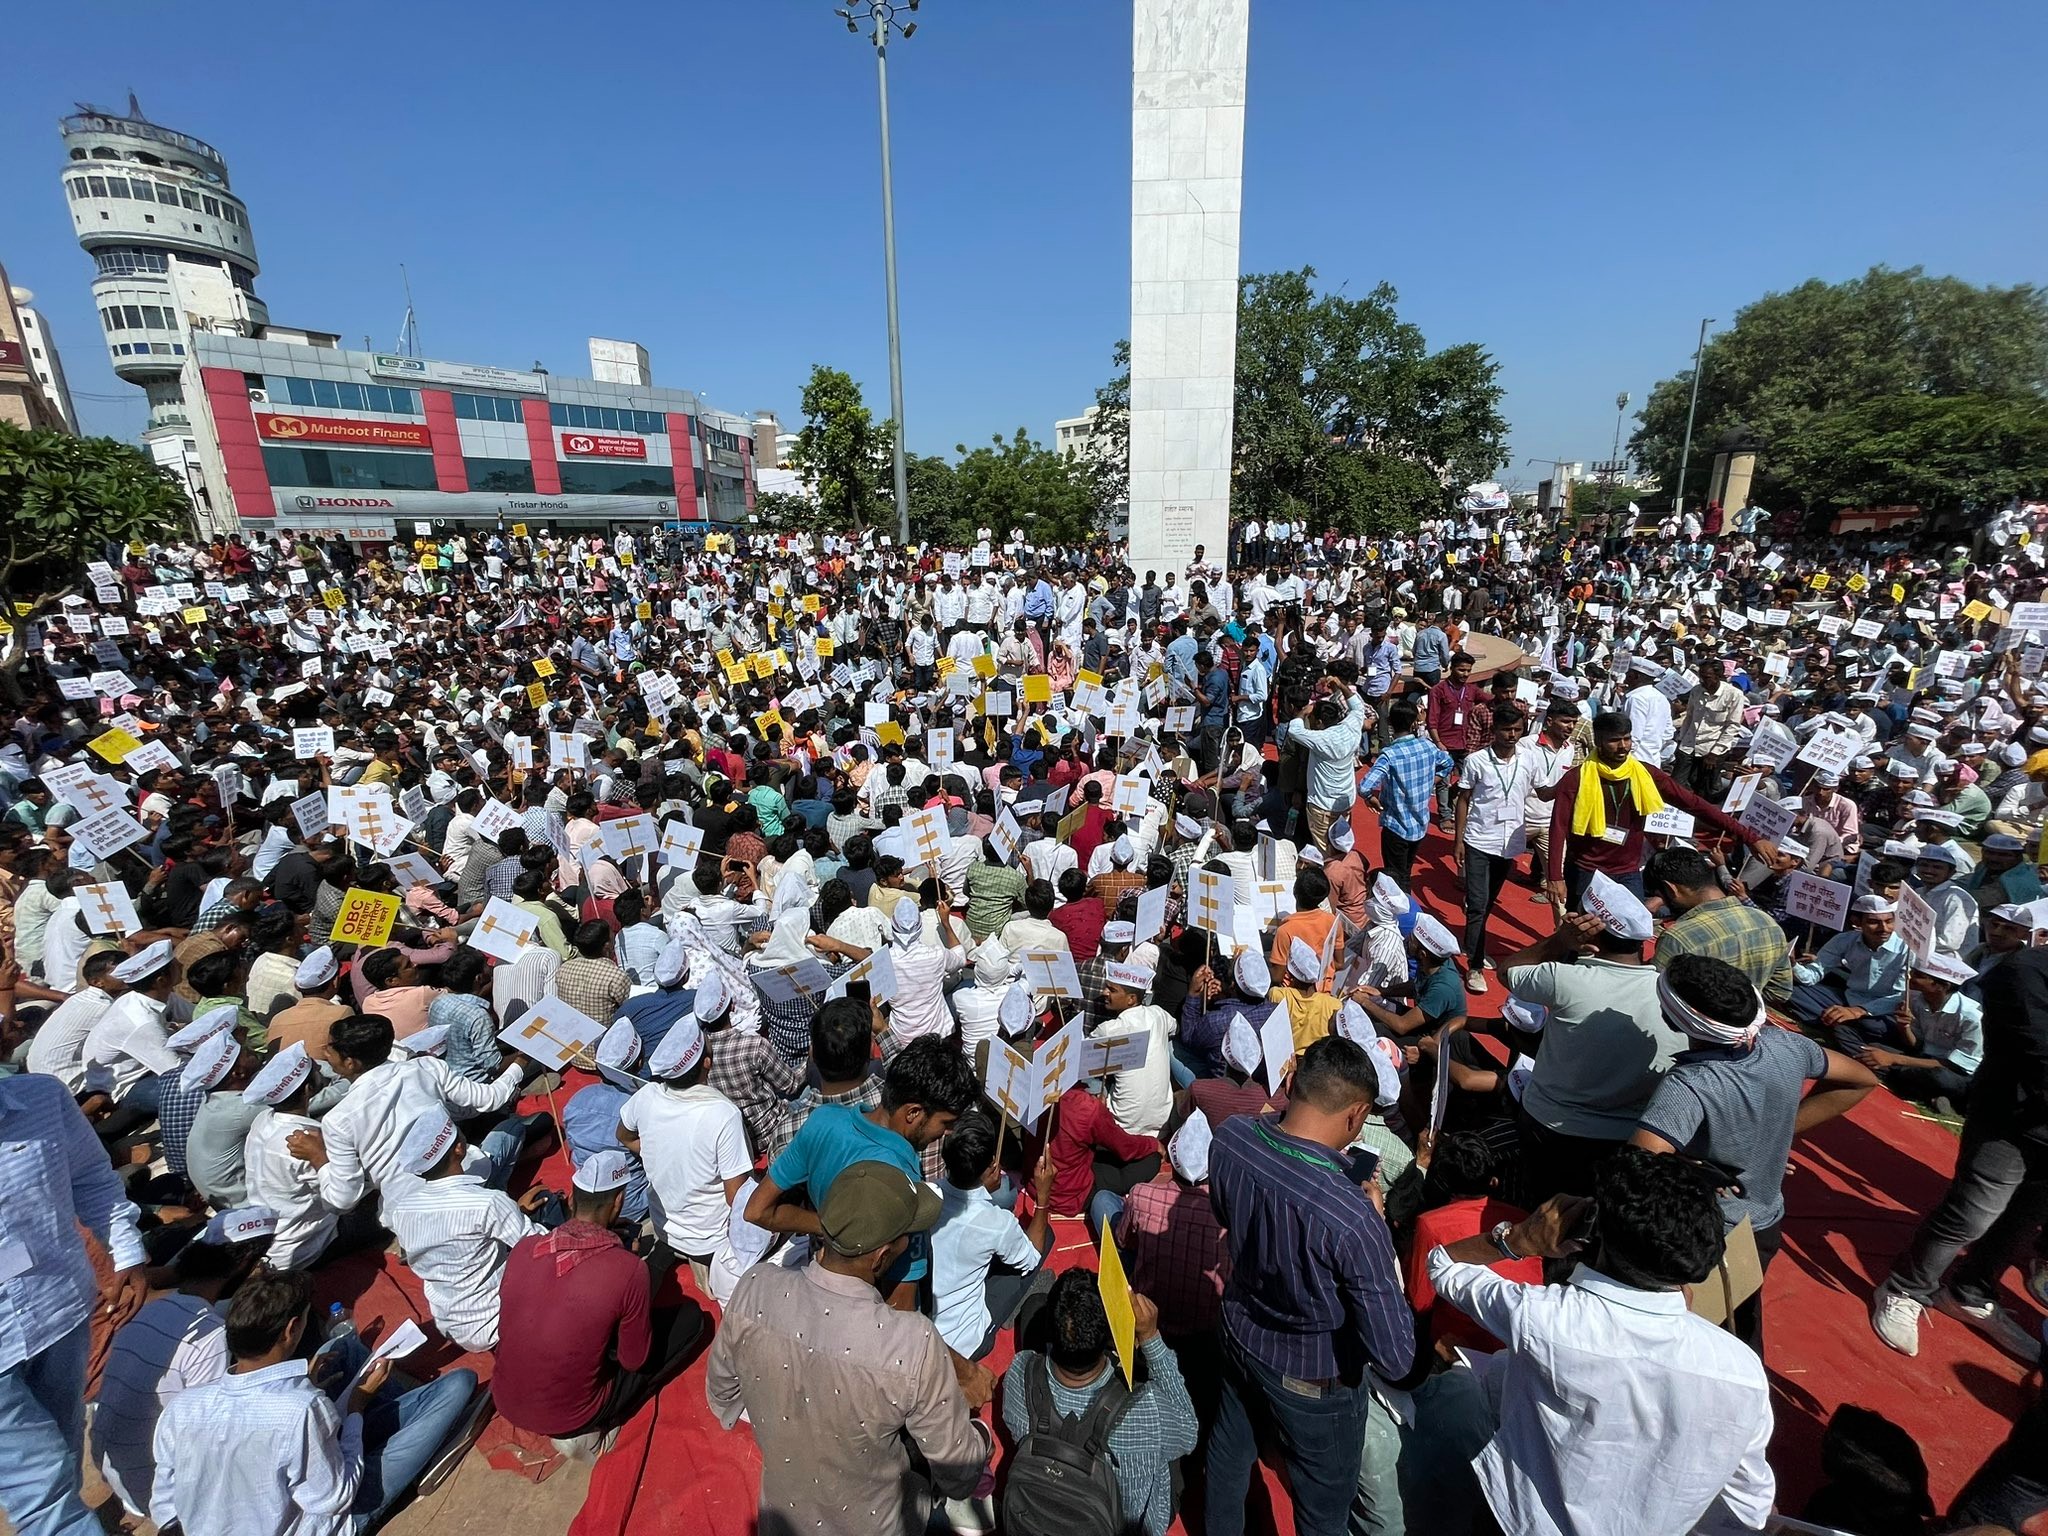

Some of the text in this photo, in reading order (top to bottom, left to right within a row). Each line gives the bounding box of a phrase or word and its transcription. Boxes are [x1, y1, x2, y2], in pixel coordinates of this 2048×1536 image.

[311, 423, 420, 440] Muthoot Finance
[317, 497, 393, 507] HONDA
[508, 501, 568, 509] Tristar Honda
[349, 529, 387, 538] BLDG
[333, 590, 344, 604] OBC
[759, 712, 776, 724] OBC
[1652, 812, 1670, 820] OBC
[1745, 813, 1760, 826] OBC
[1651, 820, 1669, 828] OBC
[91, 834, 110, 846] OBC
[342, 900, 364, 935] OBC
[355, 902, 372, 935] आरक्षण
[374, 906, 390, 936] दूर करो
[1599, 908, 1611, 921] दूर
[1816, 908, 1835, 921] हमारा
[1416, 926, 1427, 938] OBC
[714, 996, 725, 1011] OBC
[672, 1047, 694, 1072] विसंगति
[267, 1056, 309, 1100] विसंगति दूर करो
[423, 1125, 452, 1161] विसंगति दूर
[237, 1219, 261, 1233] OBC
